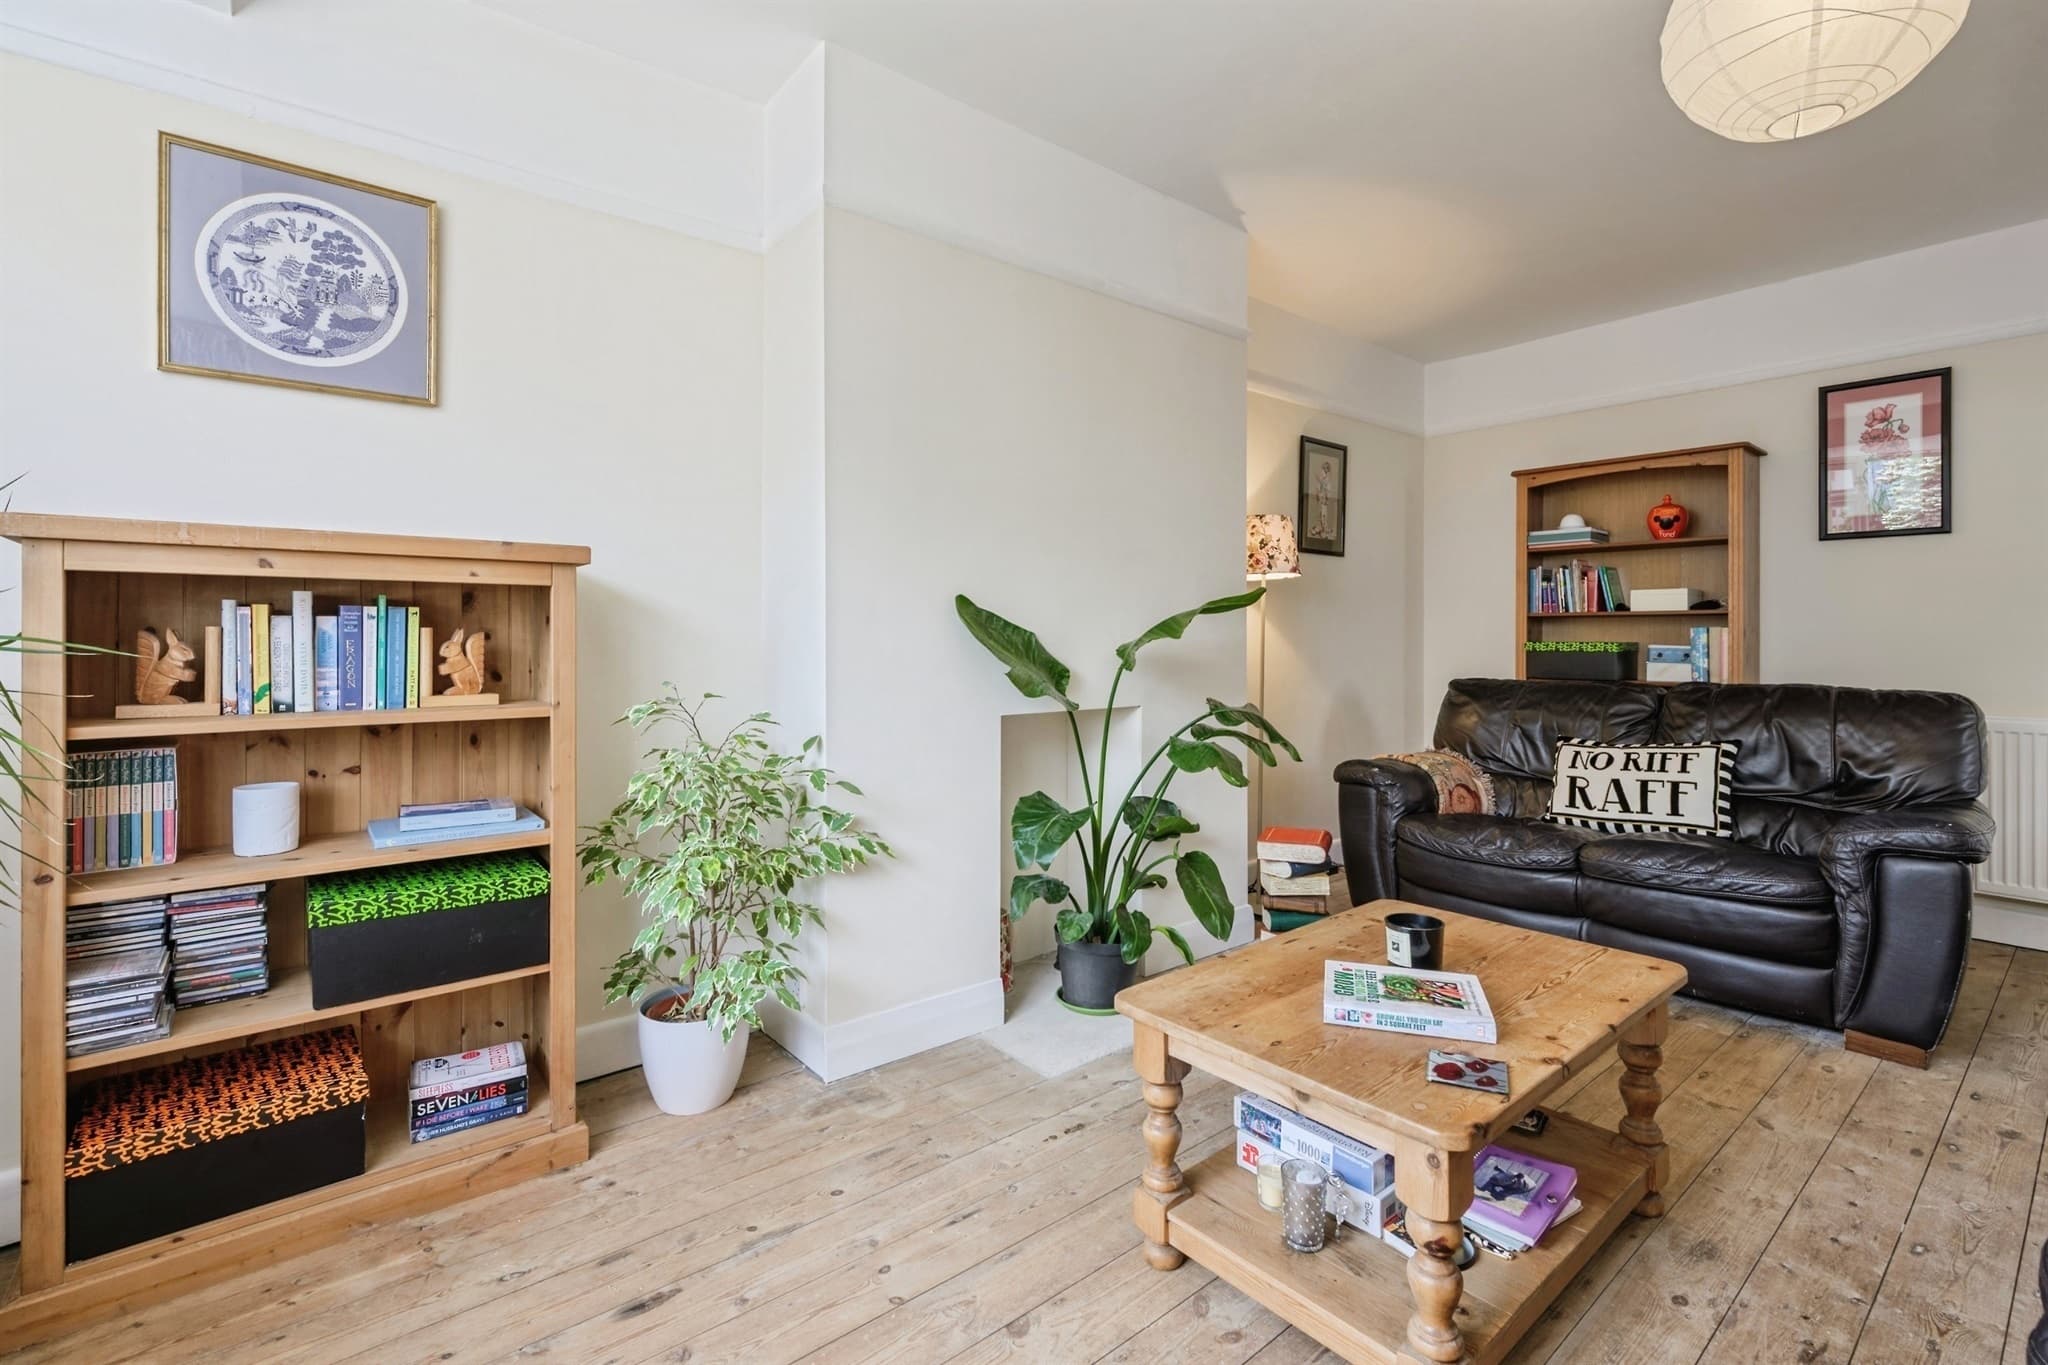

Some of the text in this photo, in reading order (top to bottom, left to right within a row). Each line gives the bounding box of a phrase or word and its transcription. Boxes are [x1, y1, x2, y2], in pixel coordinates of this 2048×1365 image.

[345, 639, 356, 689] ERAGON
[1568, 750, 1699, 774] NO RIFF
[1565, 775, 1698, 817] RAFF
[1334, 970, 1354, 996] GROW
[417, 1091, 470, 1116] SEVEN
[479, 1083, 507, 1099] LIES
[1297, 1139, 1320, 1161] 1000
[1299, 1120, 1374, 1159] Ravensburger
